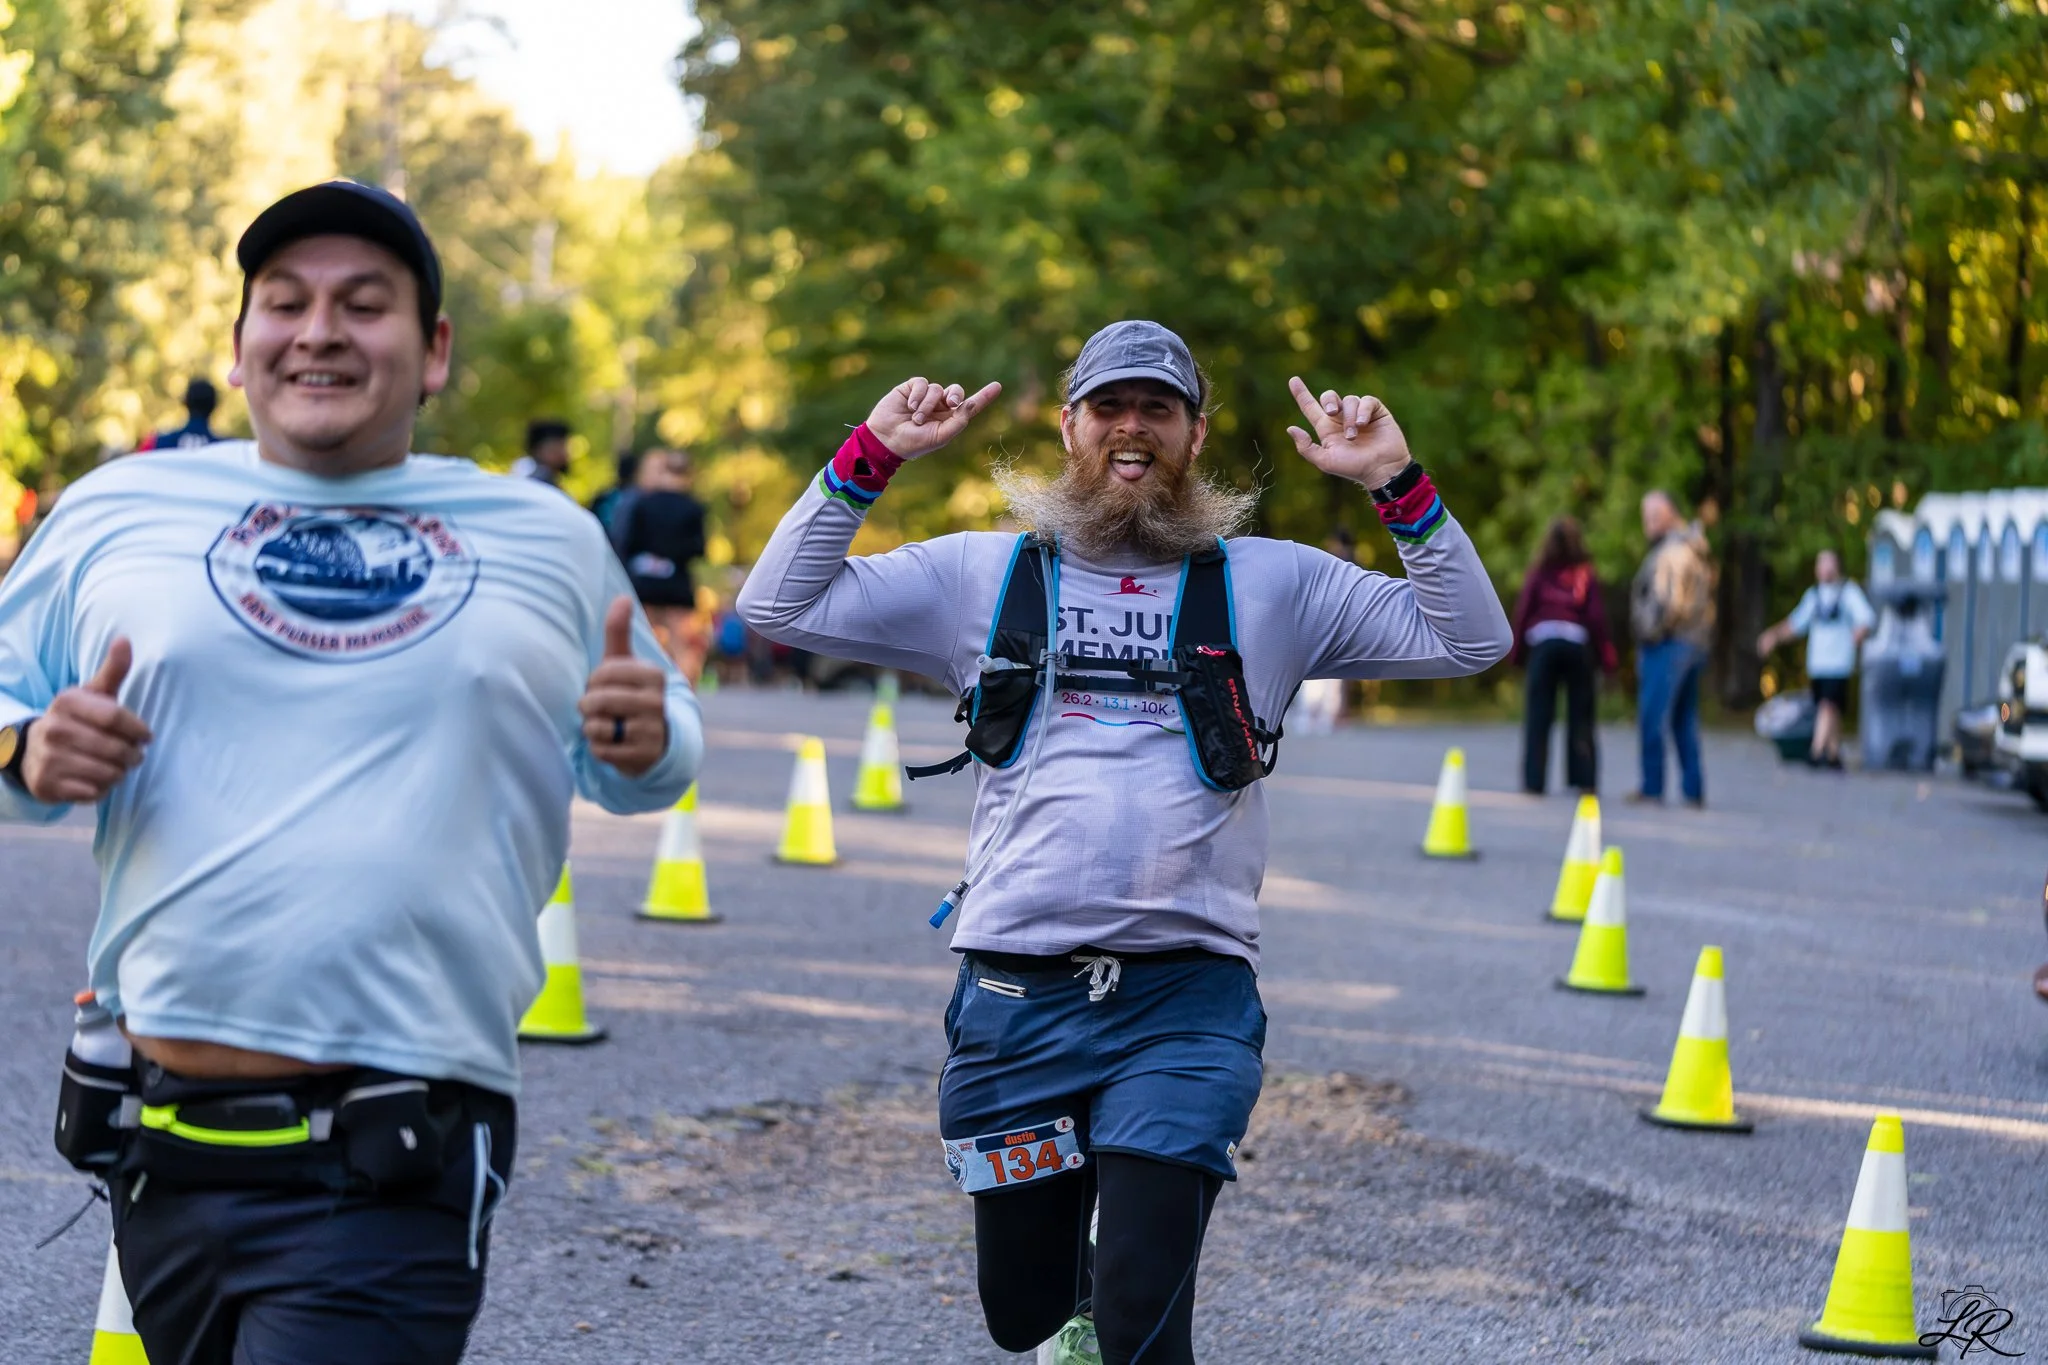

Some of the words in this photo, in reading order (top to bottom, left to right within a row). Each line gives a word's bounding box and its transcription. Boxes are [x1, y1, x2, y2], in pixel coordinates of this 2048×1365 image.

[1109, 610, 1172, 642] JU
[1062, 692, 1092, 706] 26.2
[1103, 696, 1130, 711] 13.1
[1141, 701, 1169, 716] 10K
[1004, 1131, 1037, 1146] dustin
[986, 1139, 1064, 1185] 134
